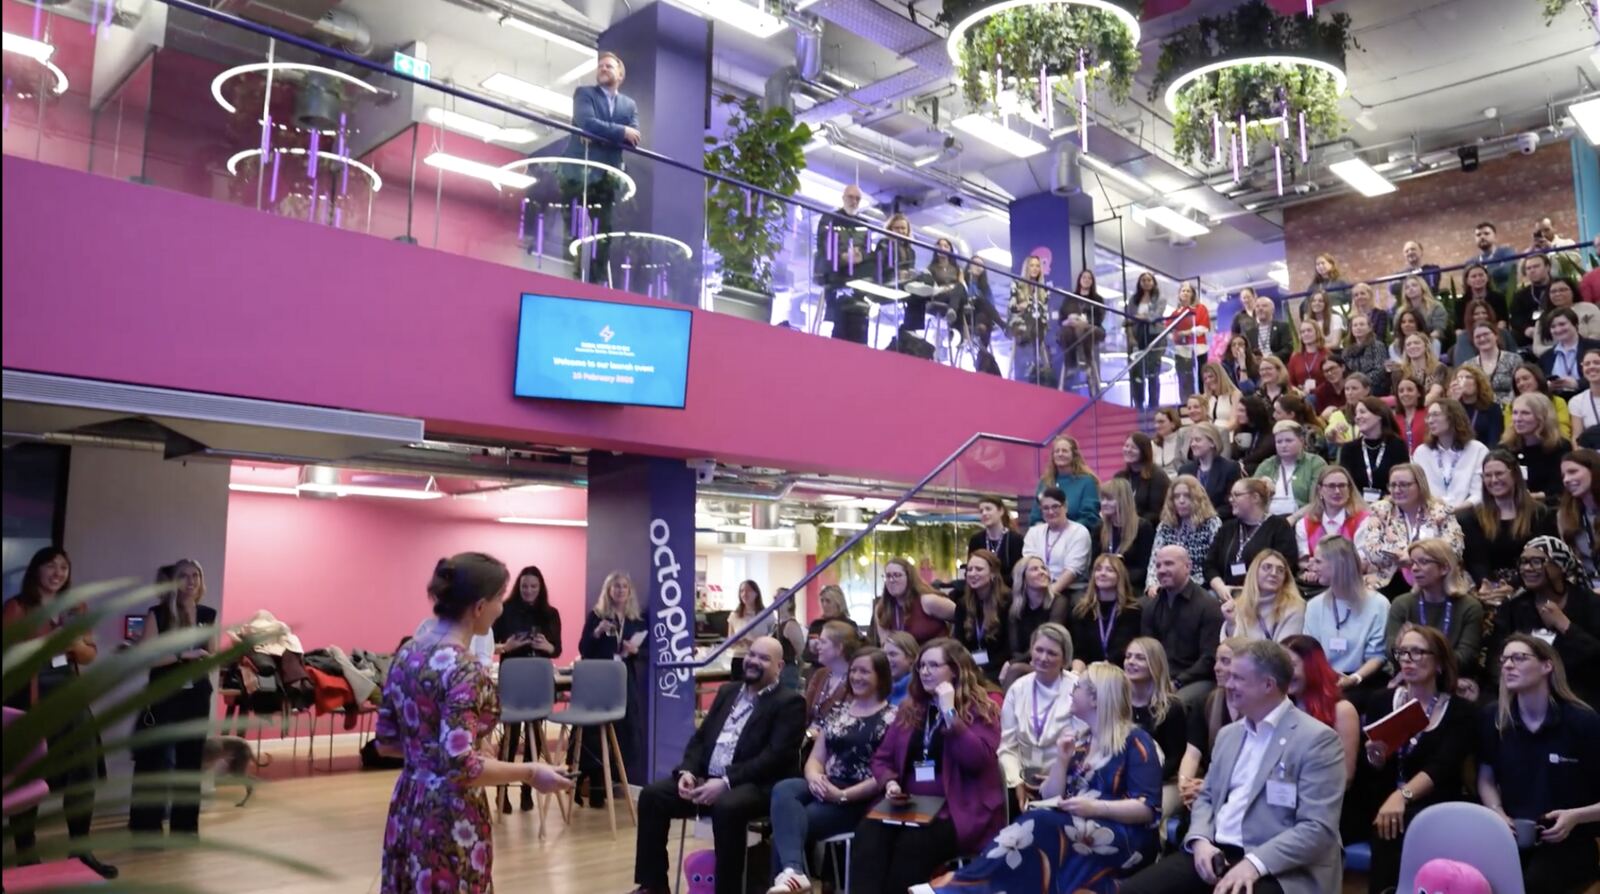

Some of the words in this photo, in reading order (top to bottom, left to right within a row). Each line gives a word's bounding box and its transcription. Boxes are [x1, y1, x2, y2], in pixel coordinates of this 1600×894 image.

[553, 356, 586, 367] Welcome
[587, 359, 596, 368] to
[597, 361, 609, 369] our
[610, 360, 634, 371] launch
[634, 364, 655, 373] event
[583, 372, 615, 384] February
[654, 622, 681, 698] enegy
